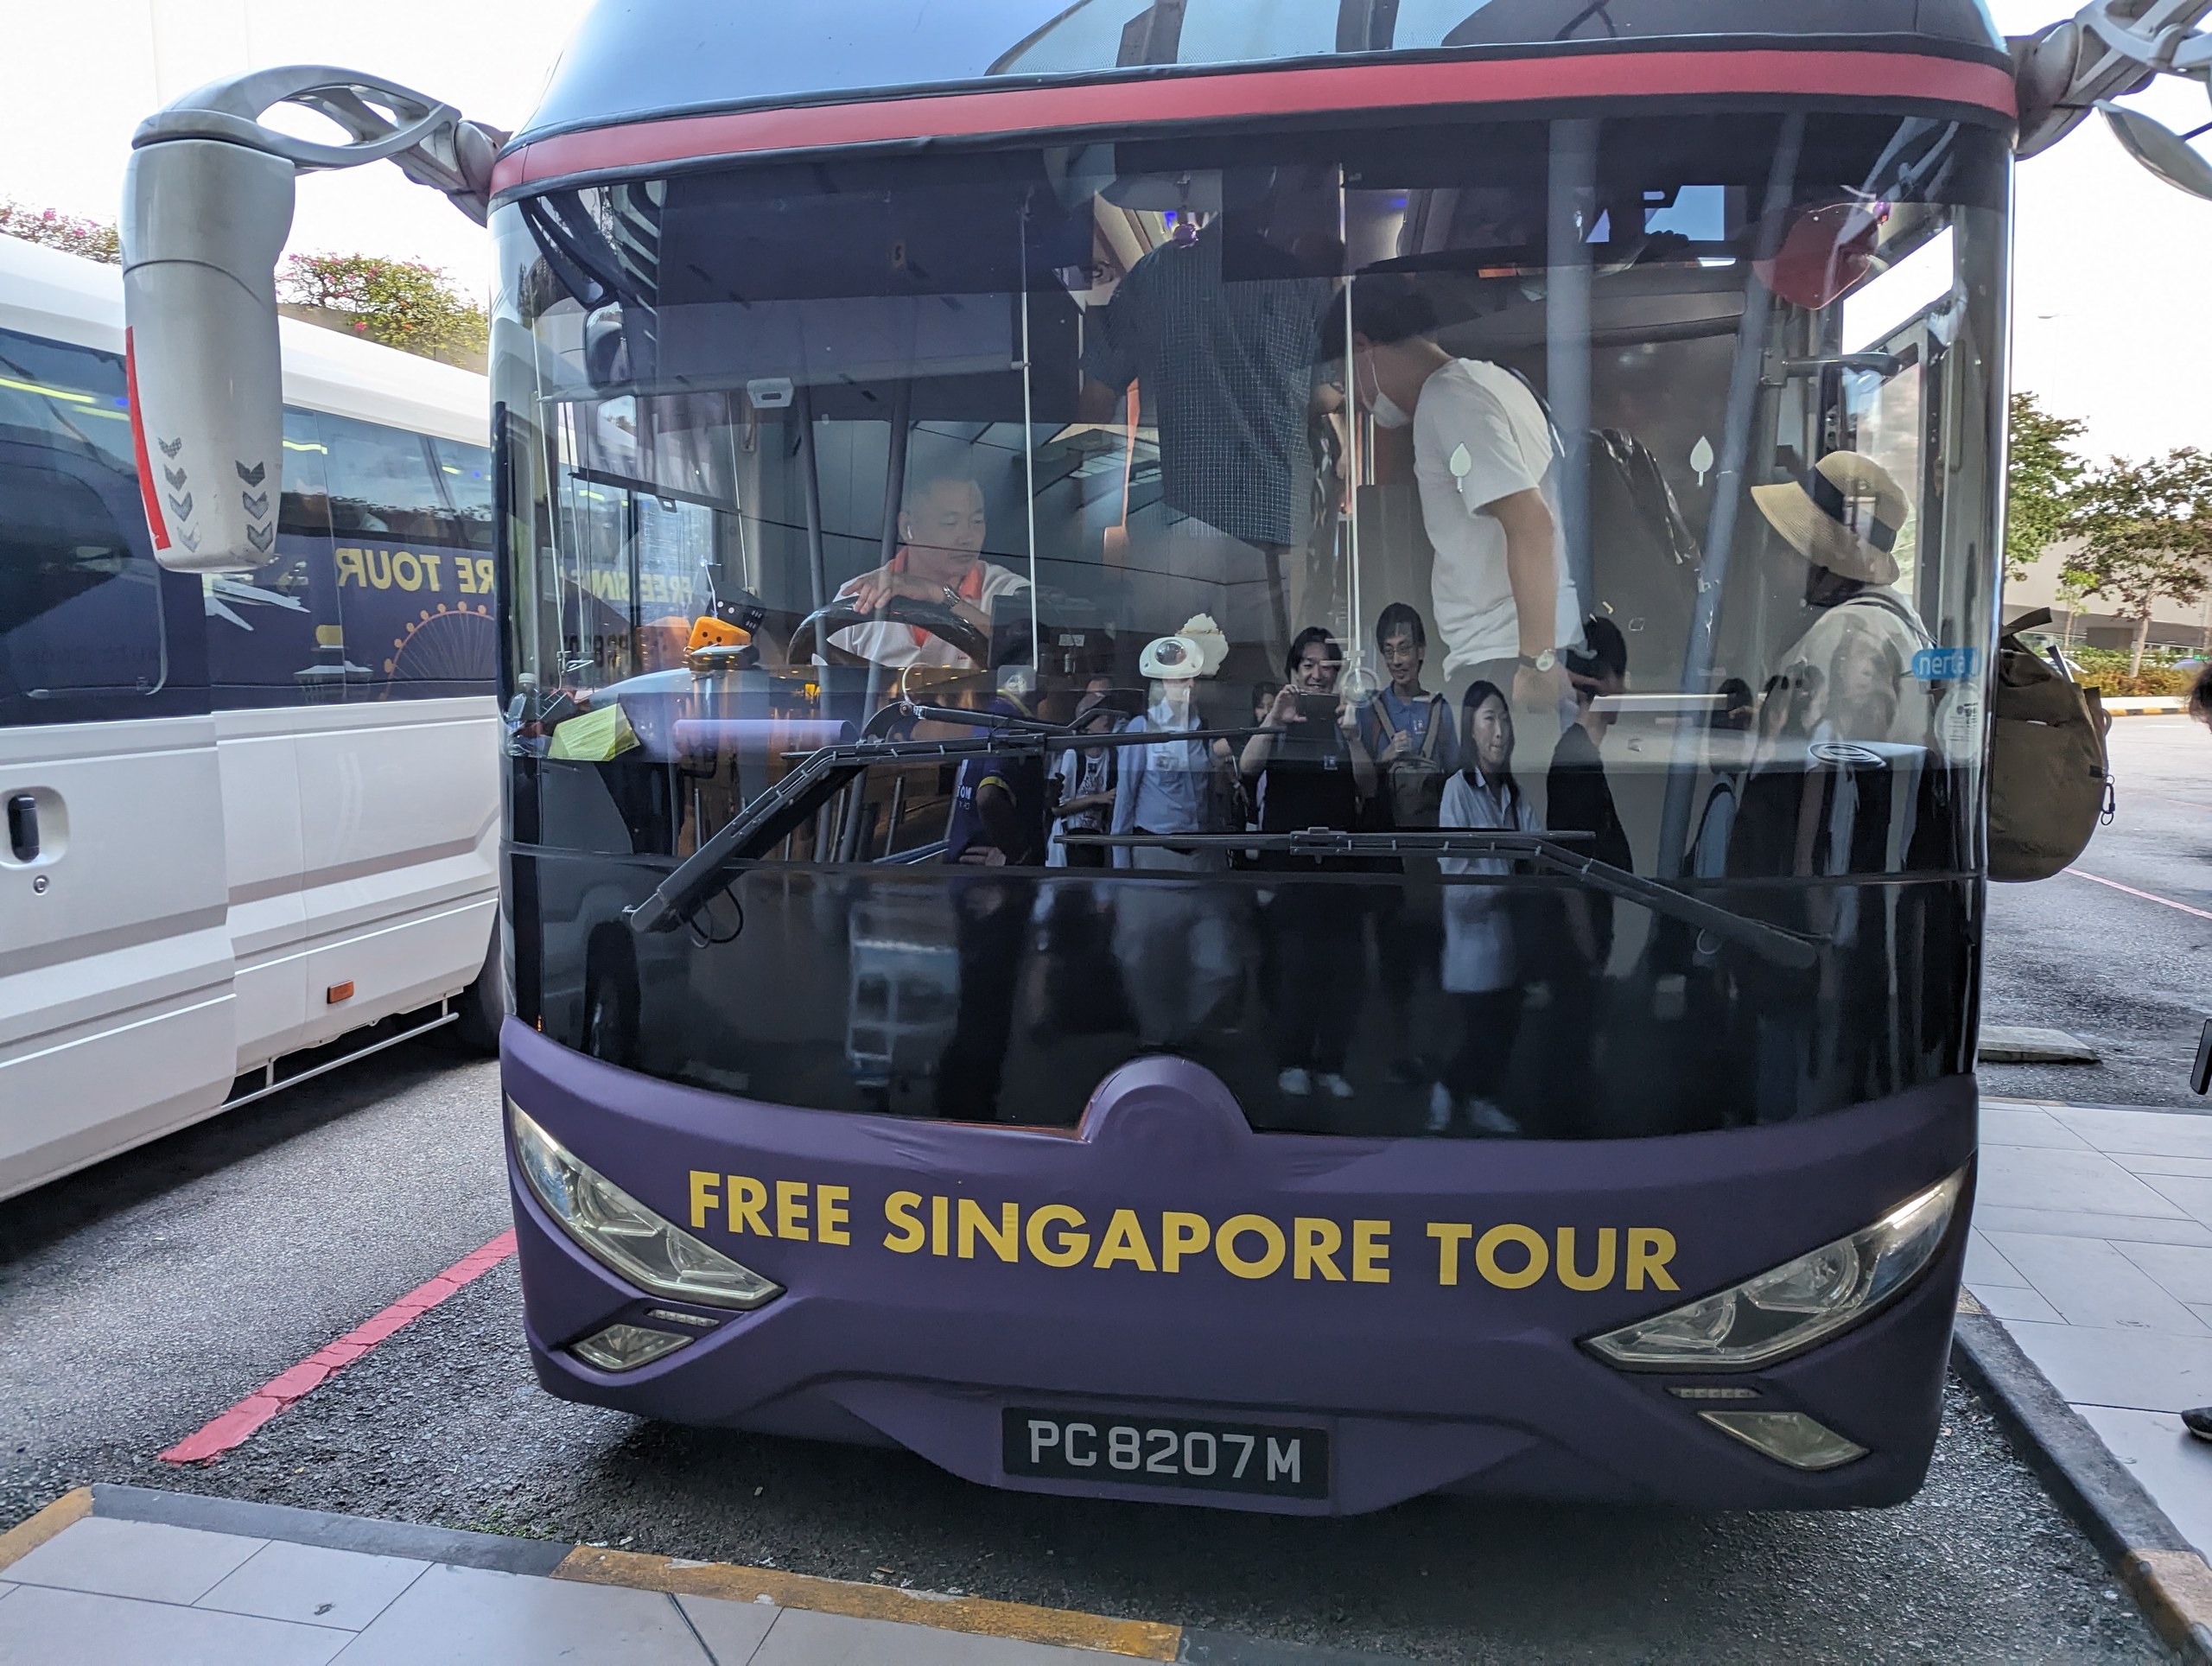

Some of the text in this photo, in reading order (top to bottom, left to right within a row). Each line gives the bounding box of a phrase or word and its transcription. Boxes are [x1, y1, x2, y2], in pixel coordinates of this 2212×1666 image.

[1919, 655, 1966, 676] nerta
[689, 1170, 1681, 1292] FREE SINGAPORE TOUR
[1027, 1420, 1301, 1484] PC8207M
